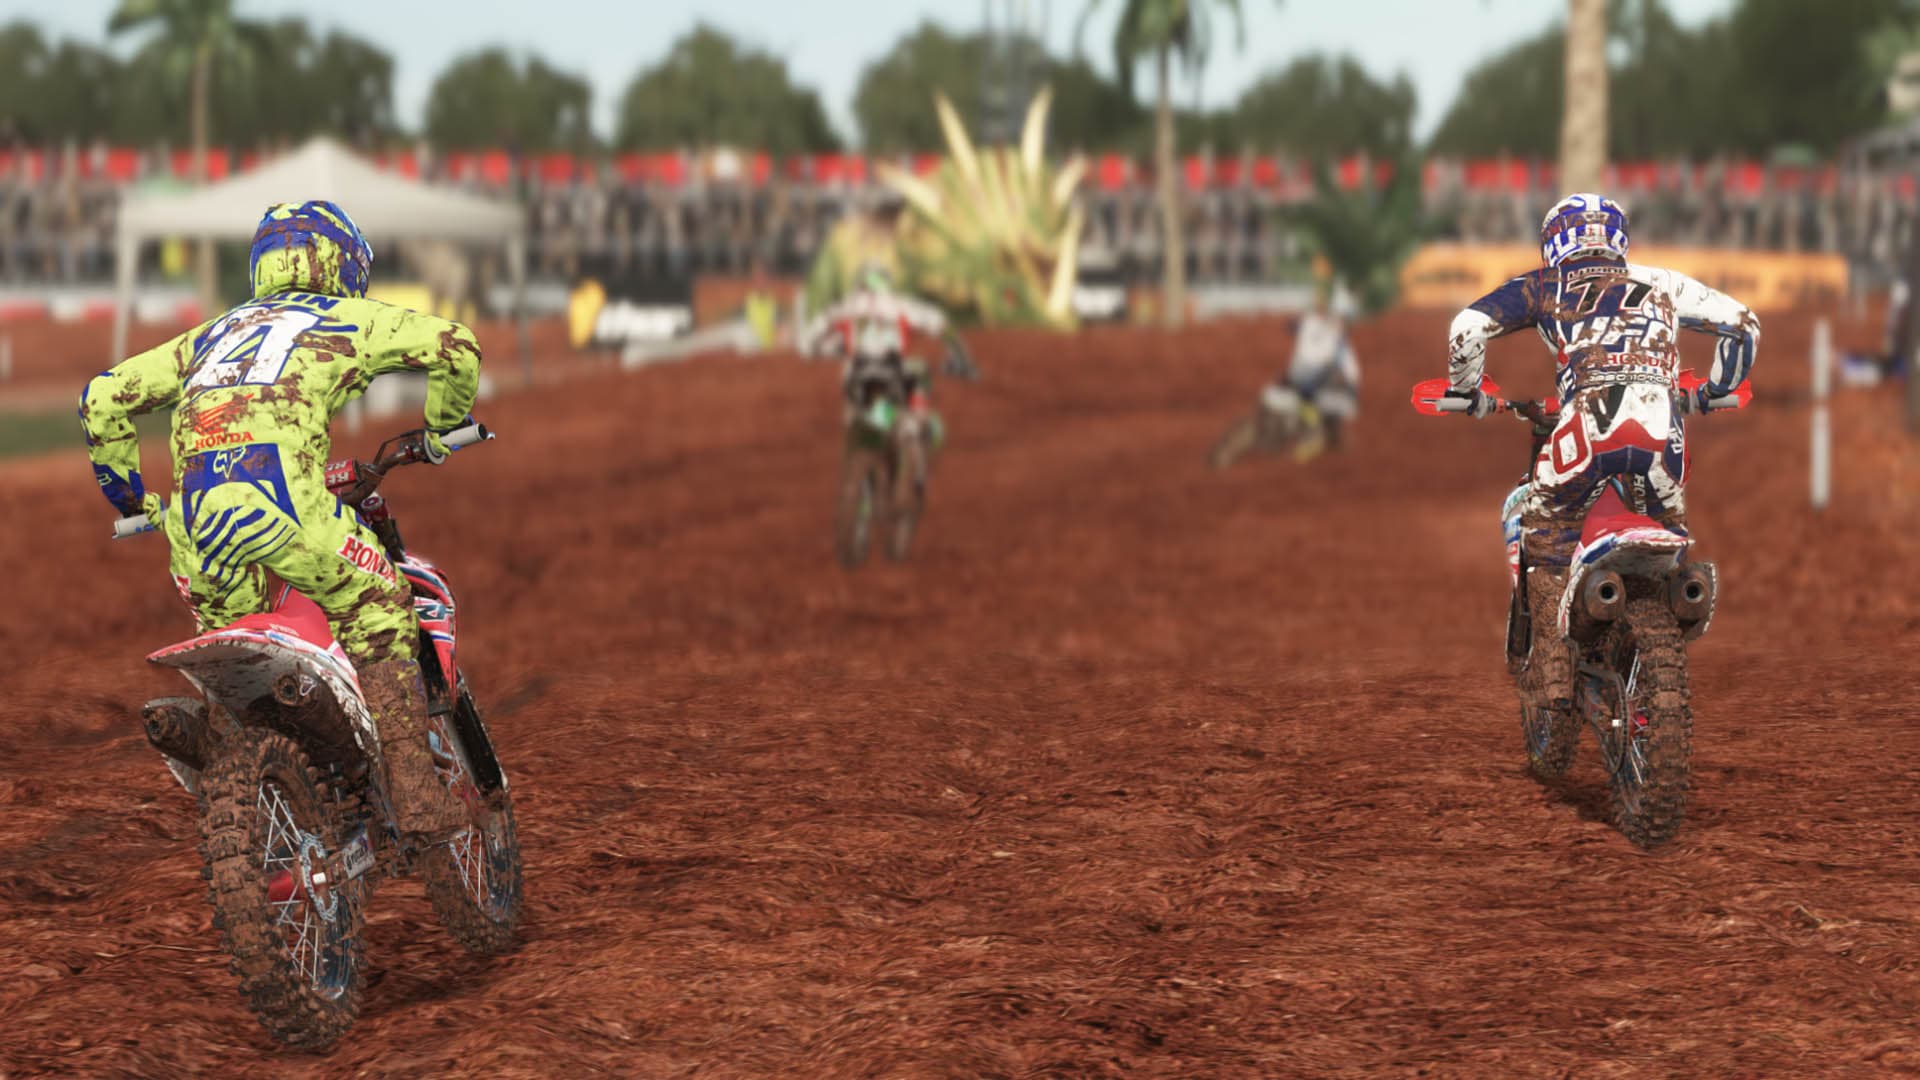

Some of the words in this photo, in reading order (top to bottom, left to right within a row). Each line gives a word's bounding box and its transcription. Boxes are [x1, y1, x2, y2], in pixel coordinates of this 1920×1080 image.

[1565, 276, 1653, 315] 77
[195, 432, 254, 450] HONDA
[340, 536, 398, 584] HONDA
